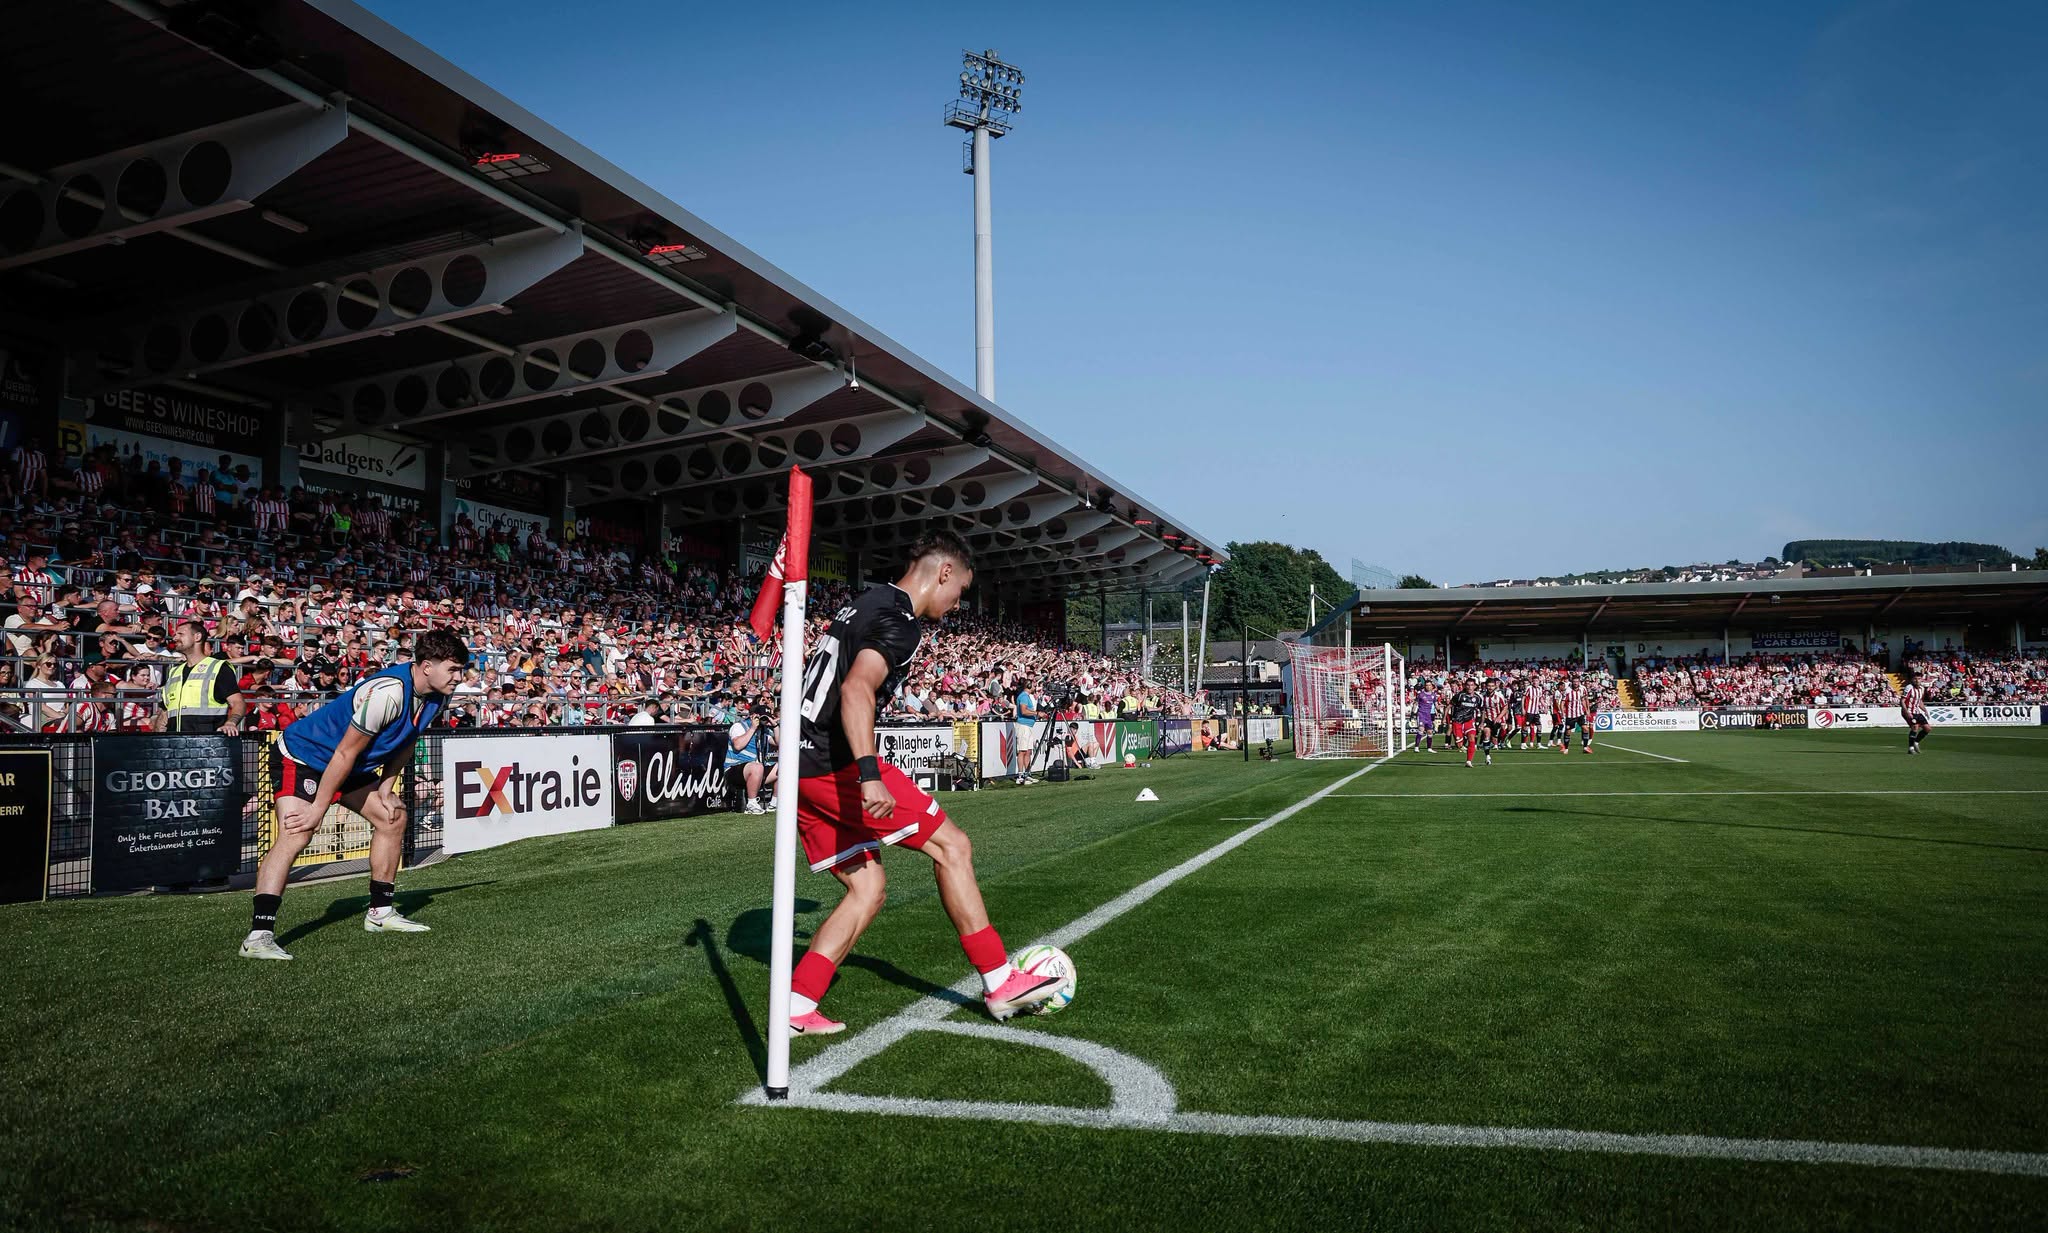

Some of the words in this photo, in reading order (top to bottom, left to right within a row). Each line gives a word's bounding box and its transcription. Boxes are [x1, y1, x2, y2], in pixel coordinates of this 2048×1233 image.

[103, 389, 167, 418] GEE'S
[171, 400, 260, 437] WINESHOP
[125, 415, 216, 447] WWW.GEESWINESHOP.CO.UK
[62, 428, 82, 457] B
[395, 495, 421, 512] LEAF
[478, 508, 499, 524] City
[501, 512, 534, 531] Contra
[808, 557, 847, 577] RNITURE
[1755, 631, 1793, 639] THREE
[1795, 631, 1837, 639] BRIDGE
[1764, 639, 1788, 647] CAR
[1791, 638, 1828, 646] SALES
[1639, 643, 1646, 653] D
[1835, 712, 1869, 722] MES
[1960, 706, 1978, 718] TK
[1983, 706, 2032, 718] BROLLY
[883, 735, 932, 753] Gallagher
[935, 734, 941, 748] &
[105, 765, 235, 793] GEORGE'S
[455, 755, 600, 820] Extra.ie
[144, 799, 200, 820] BAR
[117, 834, 136, 846] Only
[138, 833, 152, 841] the
[154, 830, 178, 840] Finest
[201, 827, 223, 835] Music,
[129, 841, 185, 853] Entertainment
[186, 839, 194, 848] &
[195, 838, 216, 846] Craic
